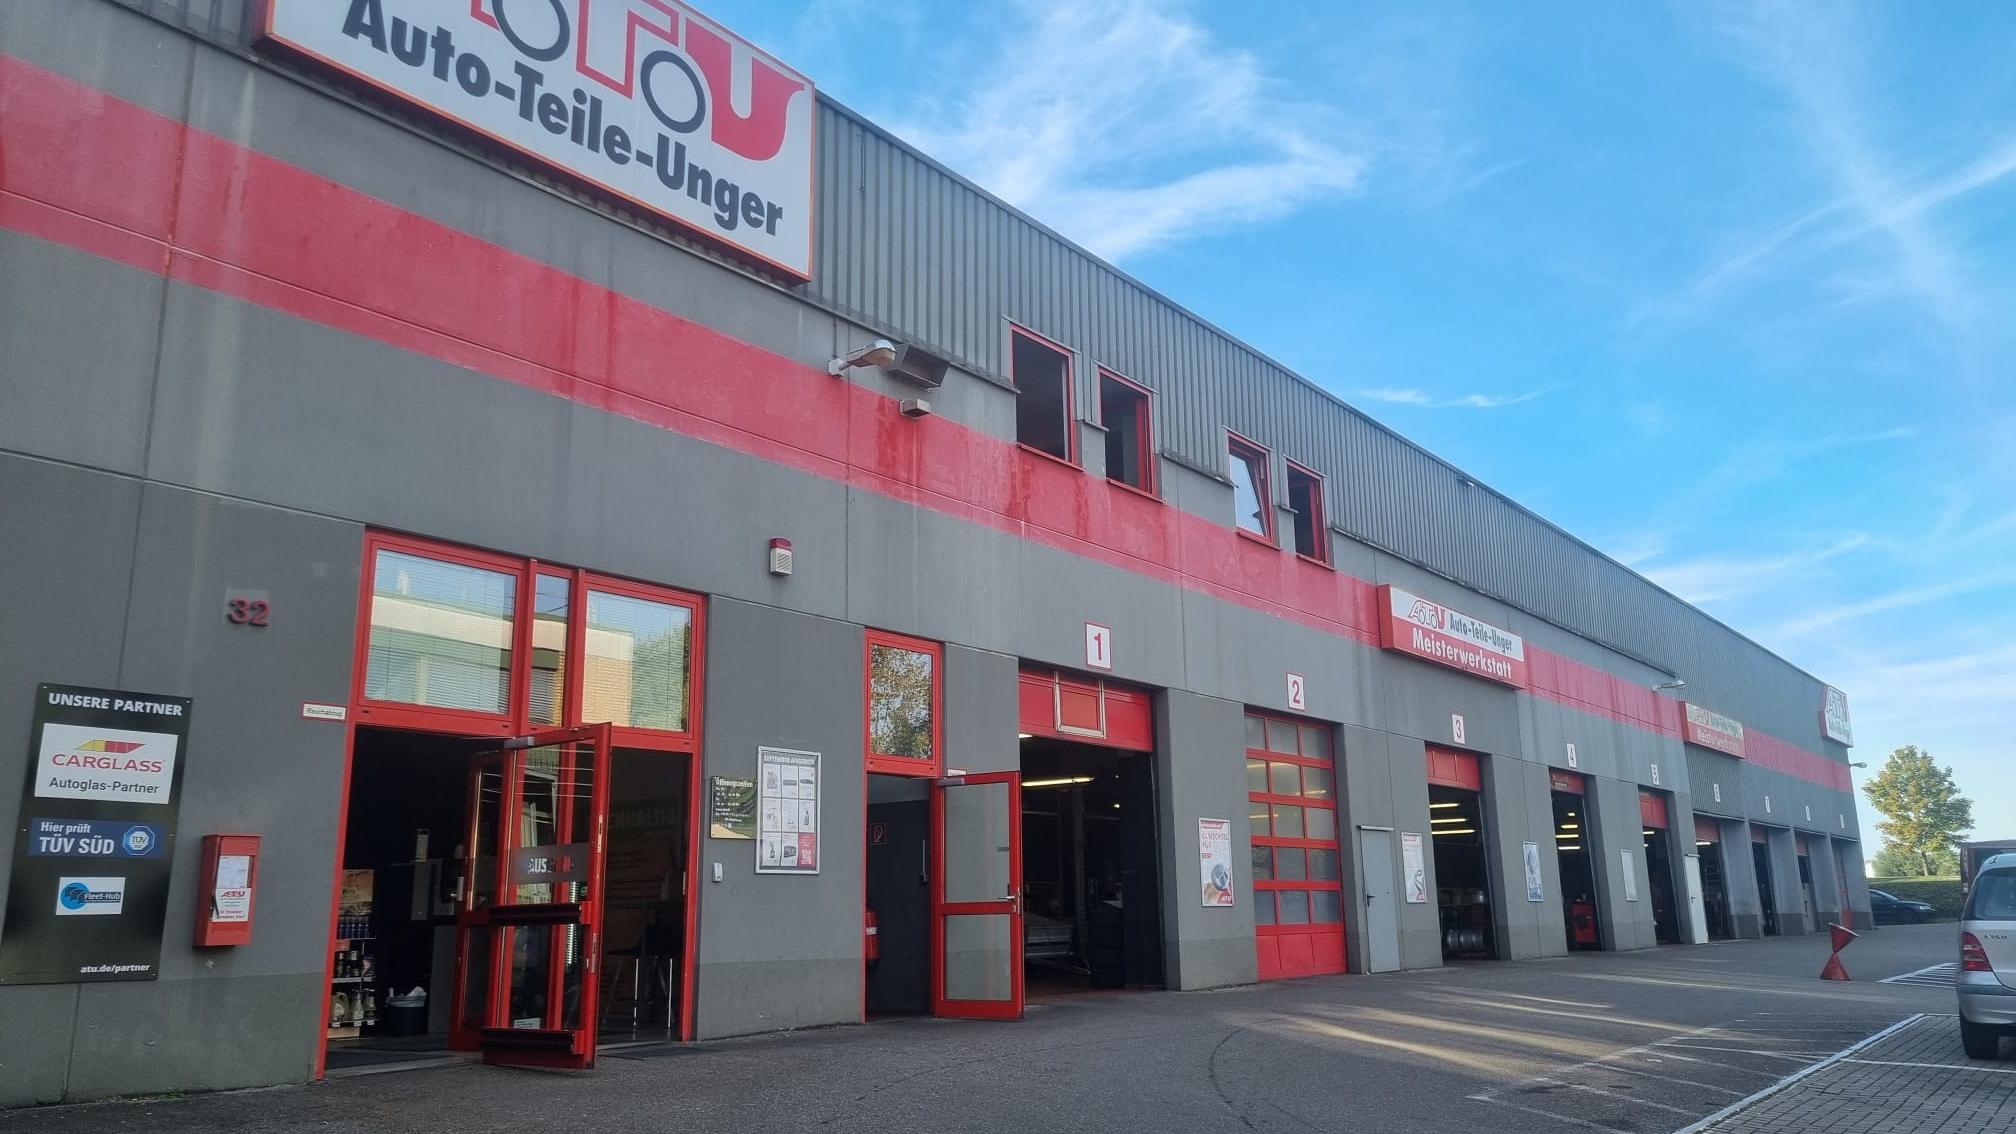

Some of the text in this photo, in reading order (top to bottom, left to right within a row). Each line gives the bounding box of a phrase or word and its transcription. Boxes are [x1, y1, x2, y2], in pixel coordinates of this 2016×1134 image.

[342, 0, 783, 236] Auto-Teile-Unger
[228, 598, 271, 626] 32
[1450, 613, 1512, 653] Auto-Teile-Unger
[1093, 632, 1102, 661] 1
[1412, 628, 1512, 679] Meisterwerkstatt
[48, 692, 183, 716] UNSERE PARTNER
[1292, 679, 1301, 705] 2
[1455, 719, 1462, 740] 3
[51, 753, 163, 773] CARGLASS
[48, 777, 160, 793] Autoglas-Partner
[40, 821, 91, 834] Hier prüft
[40, 834, 115, 855] TÜV SÜD
[80, 964, 151, 974] atu.de/partner
